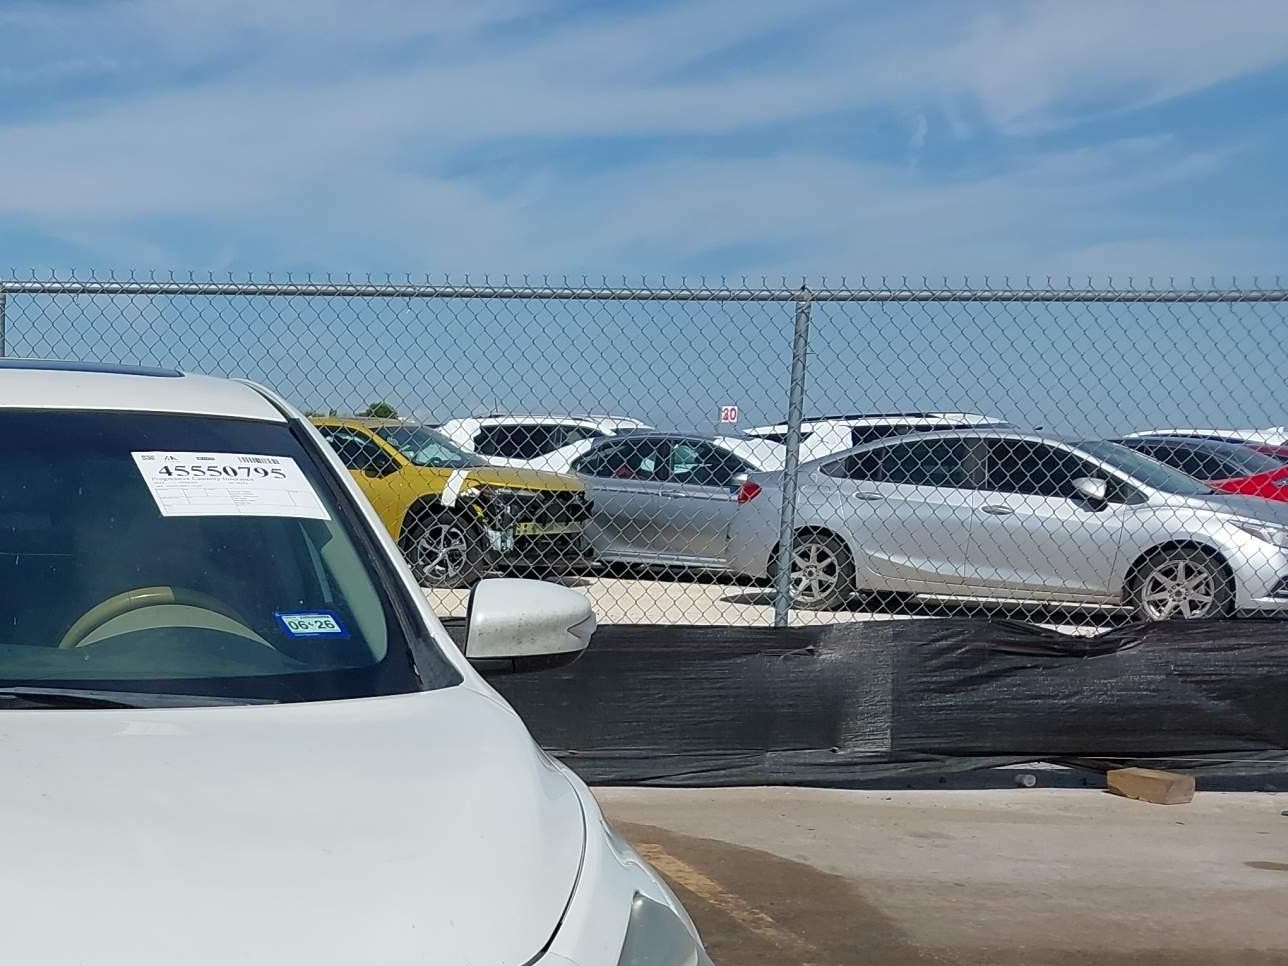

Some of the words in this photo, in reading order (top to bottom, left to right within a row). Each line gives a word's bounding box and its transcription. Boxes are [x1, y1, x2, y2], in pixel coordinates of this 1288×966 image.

[158, 465, 286, 479] 45550795
[287, 620, 309, 630] 06
[314, 619, 335, 629] 26
